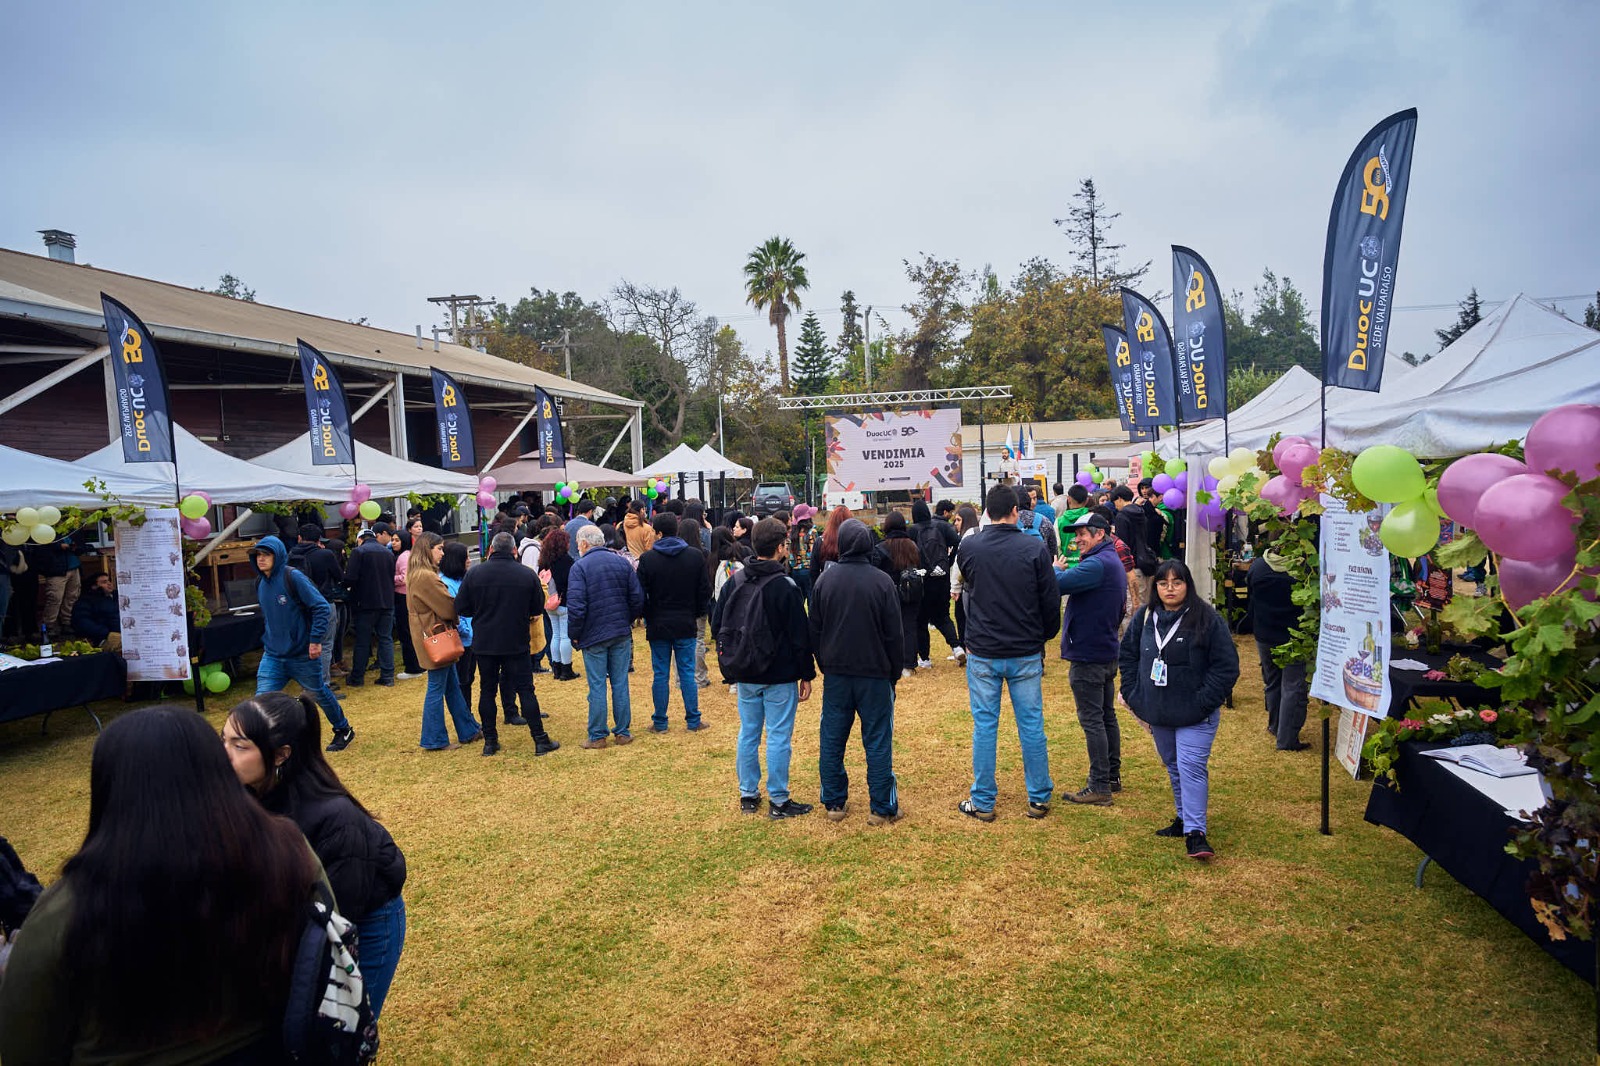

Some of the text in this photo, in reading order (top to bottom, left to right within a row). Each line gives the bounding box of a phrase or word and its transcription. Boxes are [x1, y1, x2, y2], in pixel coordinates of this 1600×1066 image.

[1360, 156, 1390, 221] 50
[1371, 266, 1392, 348] SEDE VALPARAÍSO
[862, 448, 925, 460] VENDIMIA
[883, 461, 904, 469] 2025
